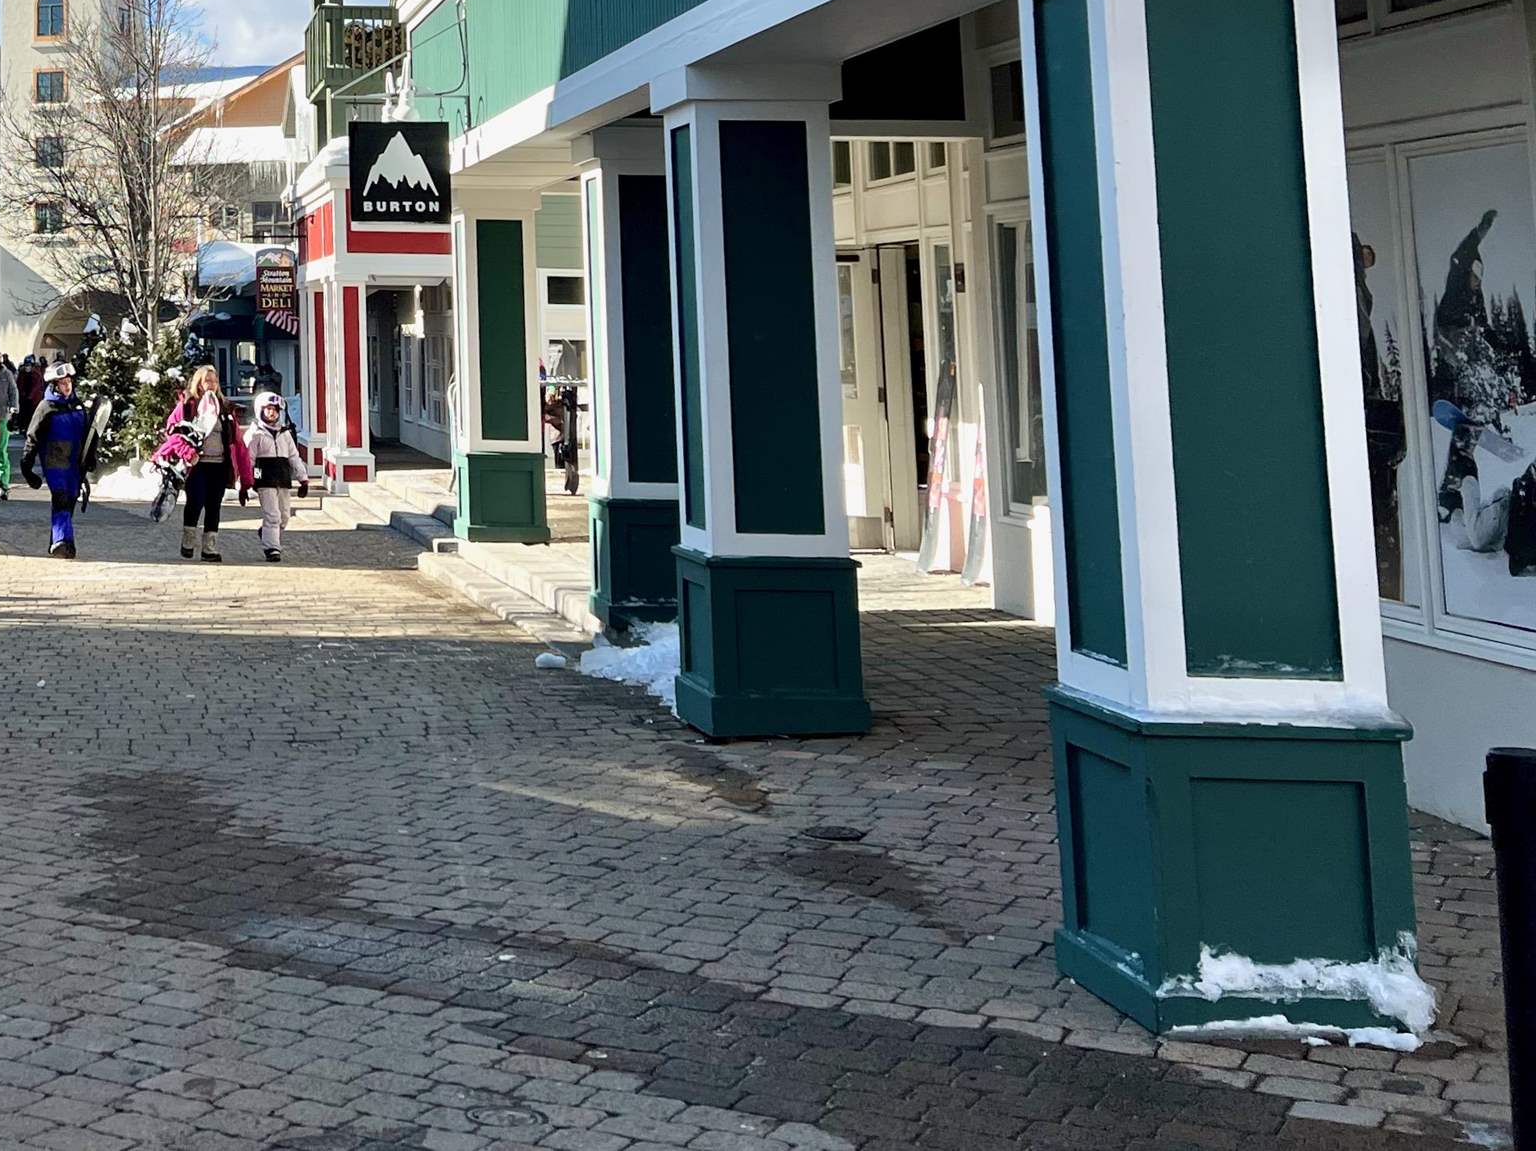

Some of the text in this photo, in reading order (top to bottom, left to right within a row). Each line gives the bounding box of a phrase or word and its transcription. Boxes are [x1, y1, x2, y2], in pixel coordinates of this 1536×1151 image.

[363, 201, 440, 212] BURTON
[262, 270, 290, 278] Stratton
[260, 284, 294, 292] MARKET
[262, 298, 291, 308] DELI
